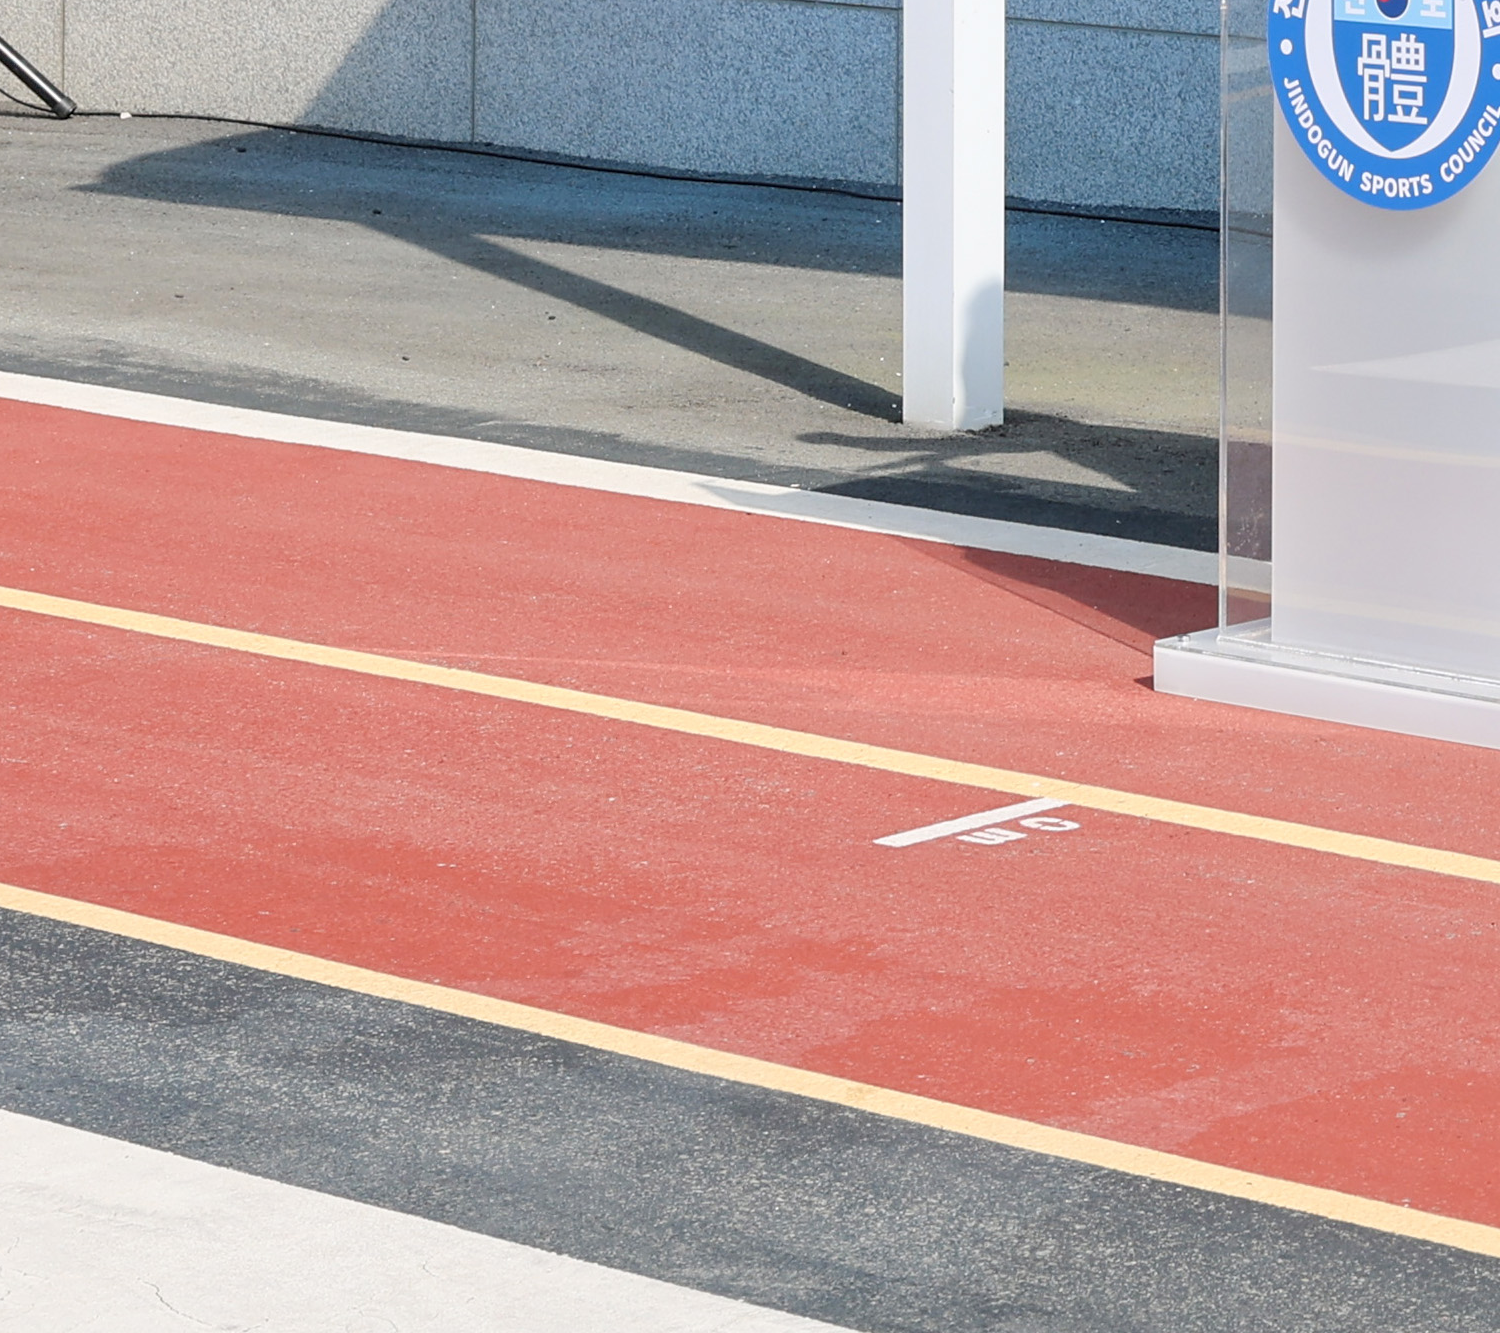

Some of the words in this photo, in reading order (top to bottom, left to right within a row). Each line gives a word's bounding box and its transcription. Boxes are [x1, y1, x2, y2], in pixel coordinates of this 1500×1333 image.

[1357, 32, 1428, 125] 體
[1283, 77, 1355, 183] JINDOGUN
[1360, 172, 1433, 199] SPORTS
